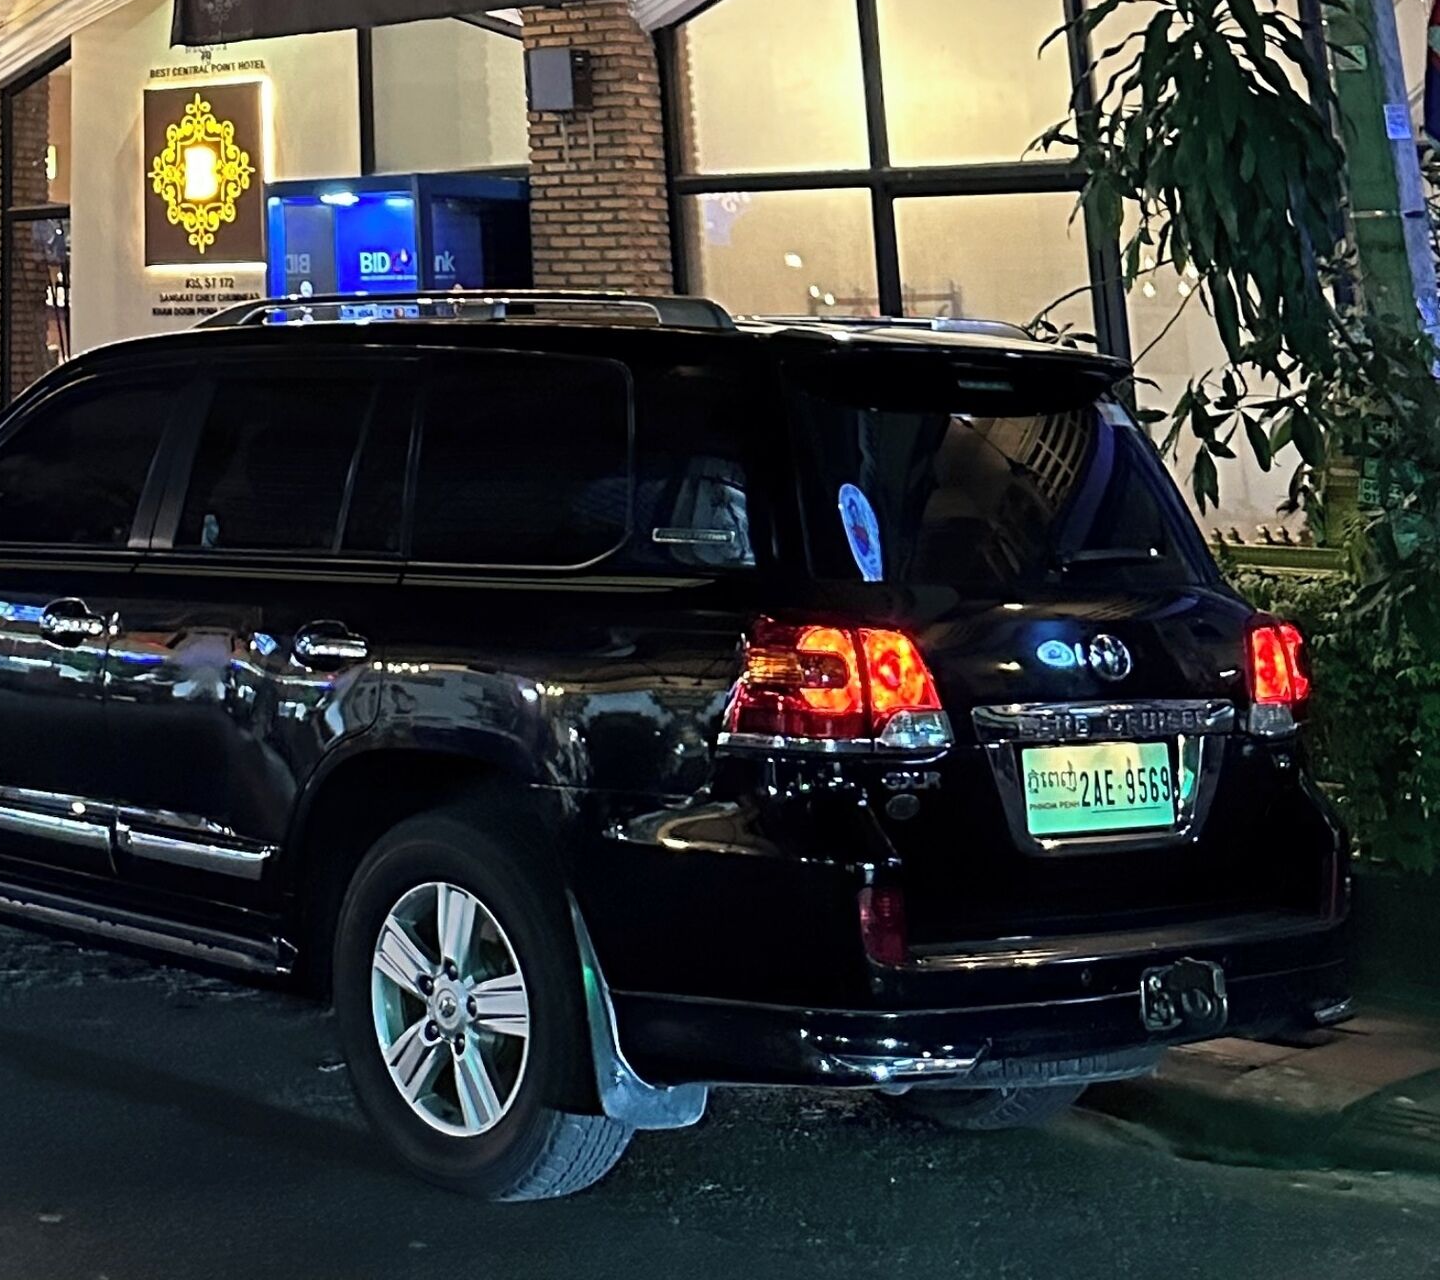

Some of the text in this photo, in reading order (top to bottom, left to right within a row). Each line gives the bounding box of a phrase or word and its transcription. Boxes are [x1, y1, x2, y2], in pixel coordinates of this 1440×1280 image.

[149, 59, 266, 79] BEST CENTRAL POINT HOTEL
[205, 277, 217, 288] ST
[219, 277, 235, 289] 172
